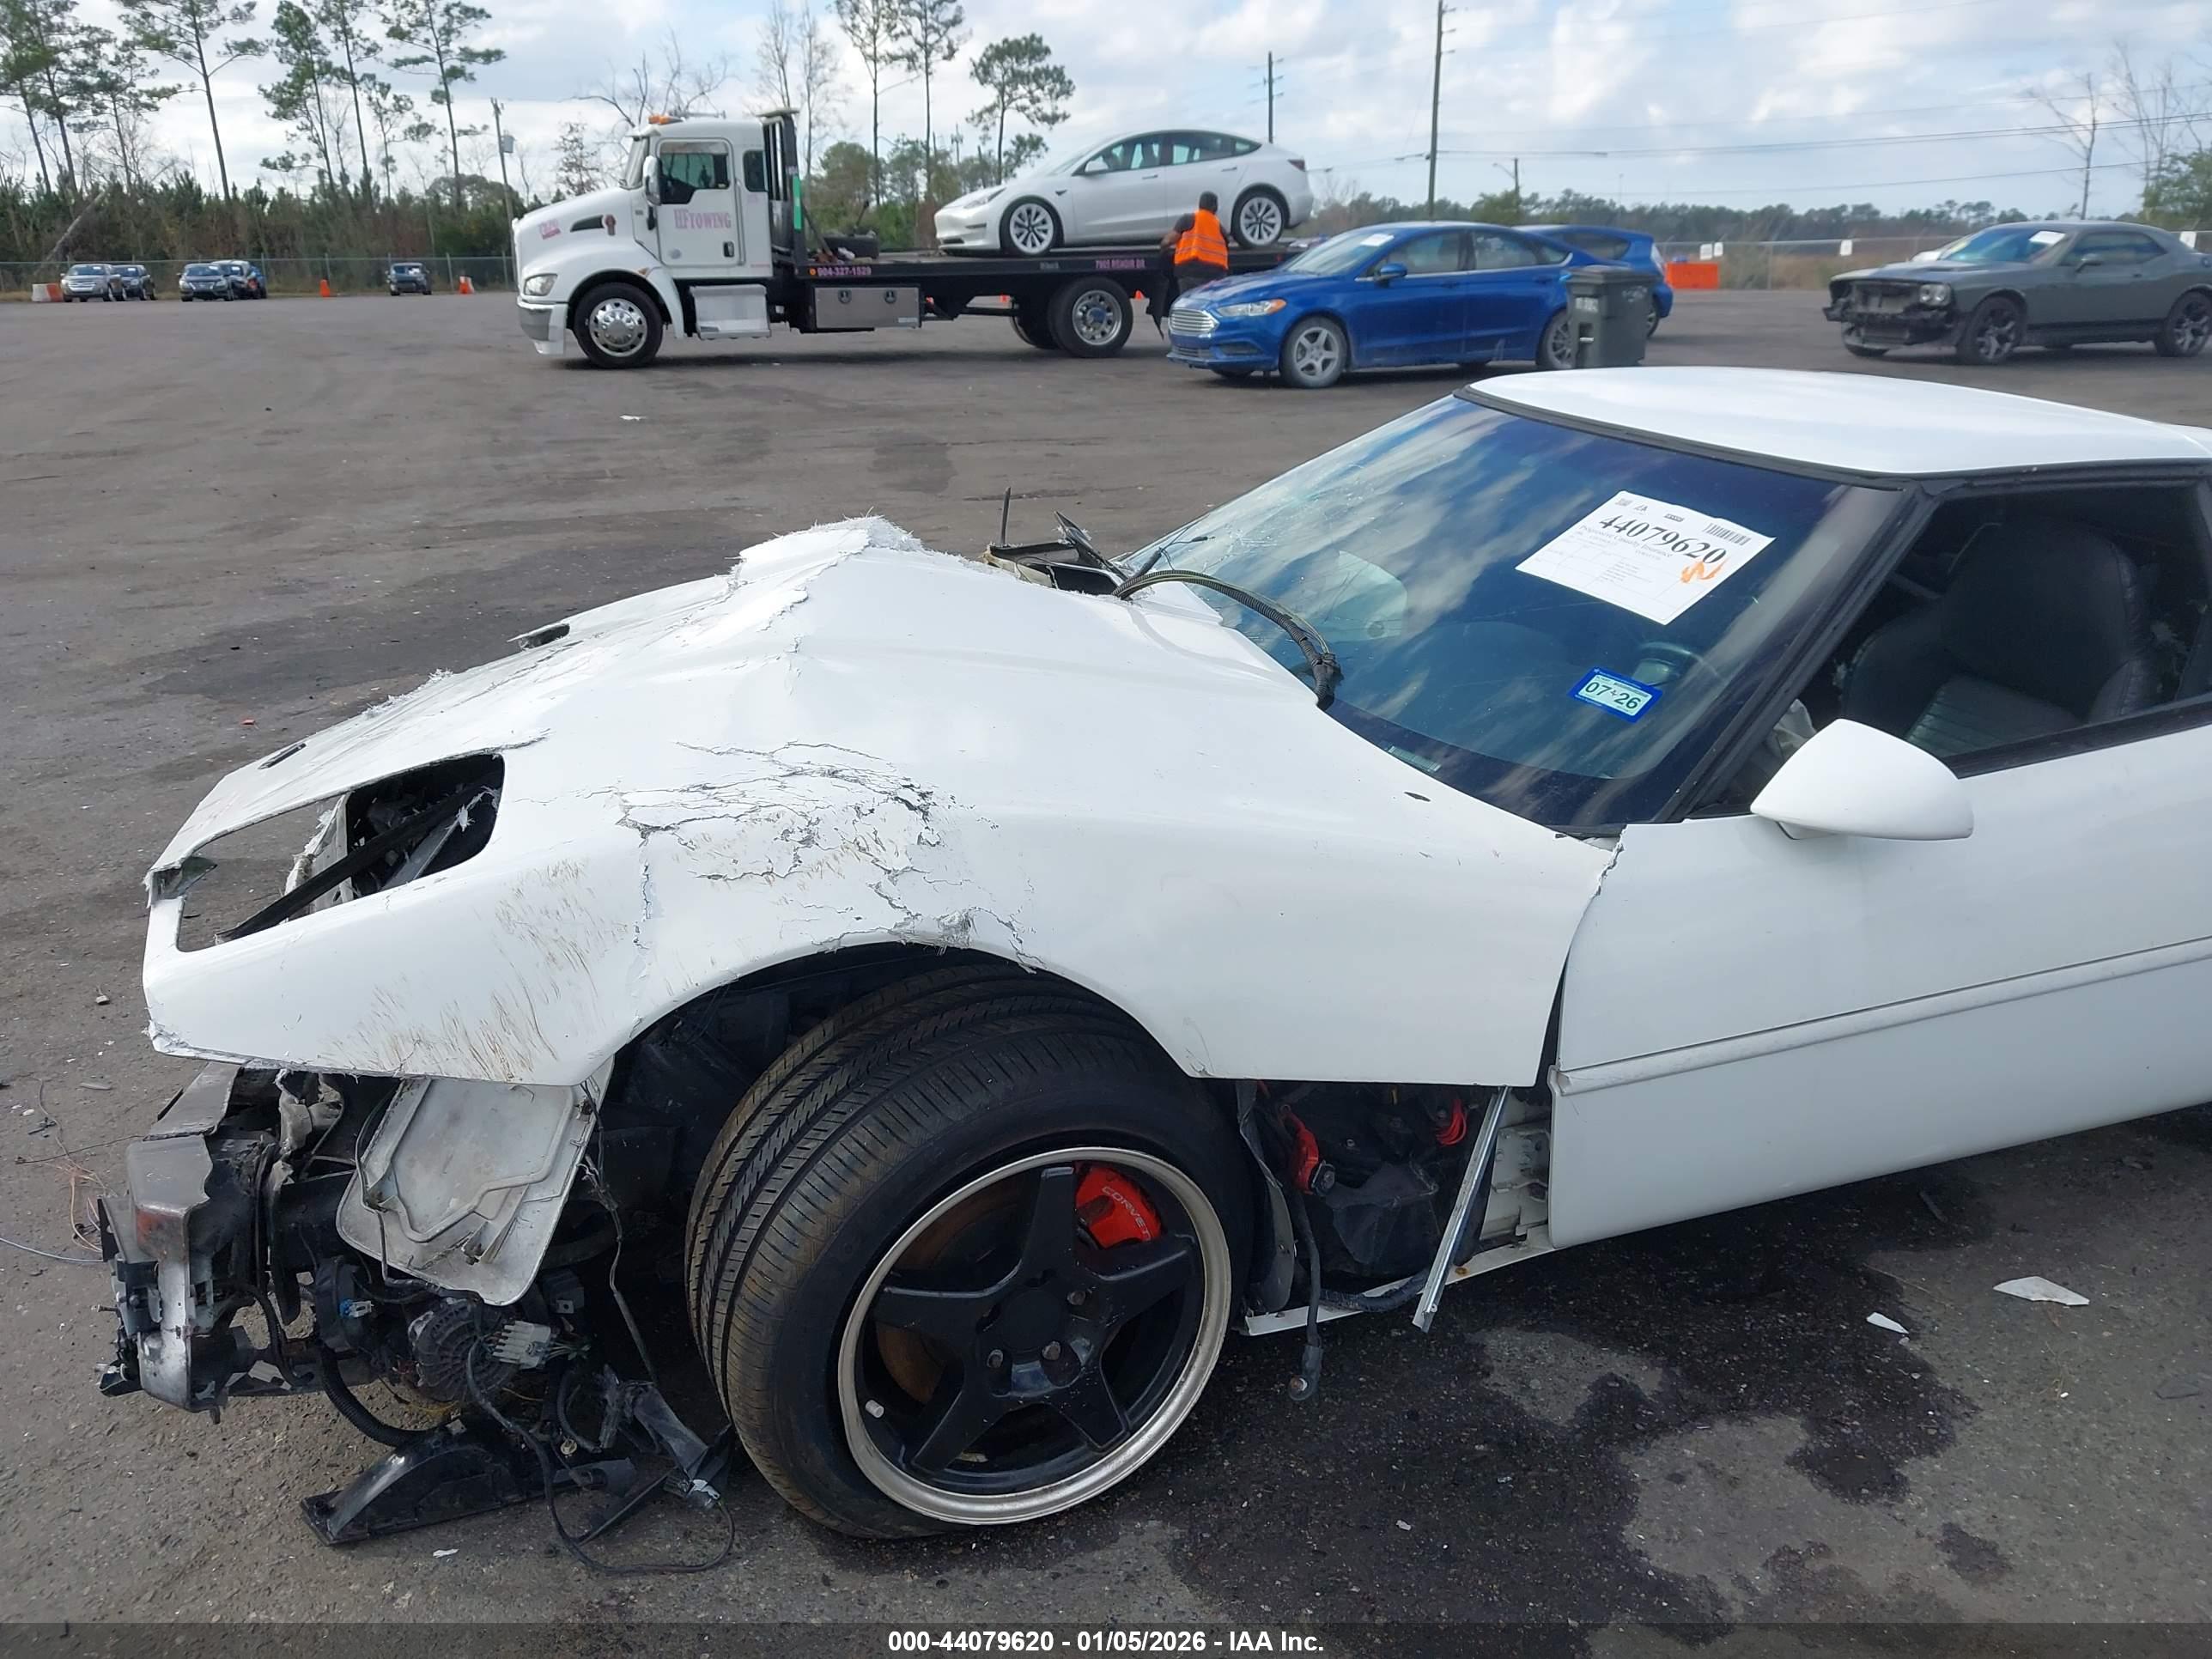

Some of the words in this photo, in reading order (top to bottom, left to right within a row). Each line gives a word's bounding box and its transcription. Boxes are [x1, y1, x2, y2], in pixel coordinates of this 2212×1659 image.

[1599, 514, 1727, 563] 44079620
[1585, 682, 1612, 696] 07
[1614, 692, 1641, 709] 26
